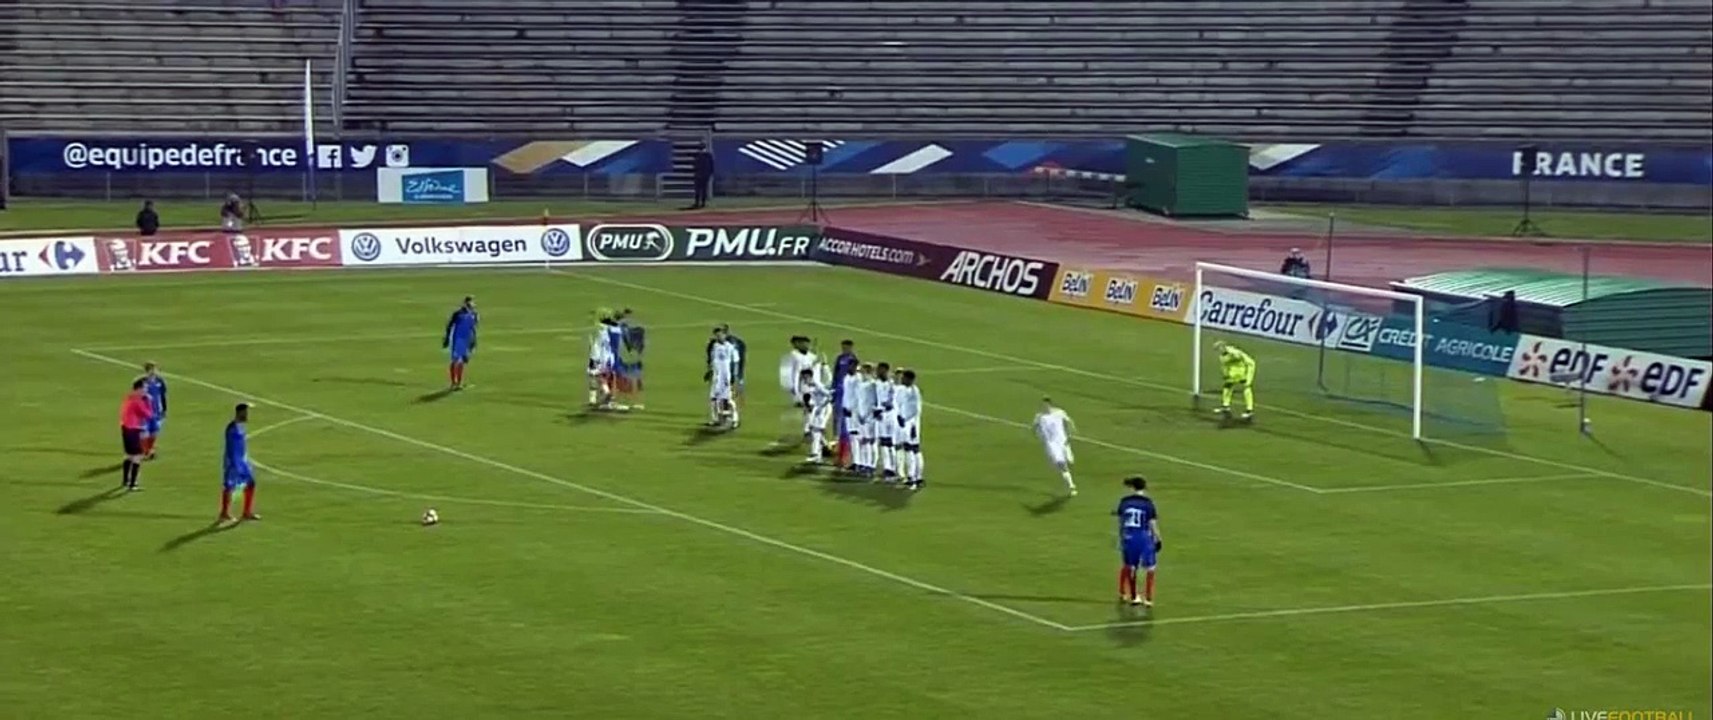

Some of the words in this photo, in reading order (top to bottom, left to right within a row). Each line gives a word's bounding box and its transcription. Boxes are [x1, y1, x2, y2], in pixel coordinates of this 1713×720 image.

[138, 241, 213, 265] KFC
[261, 237, 333, 260] KFC
[396, 237, 528, 257] Volkswagen
[599, 233, 643, 250] PMU
[685, 228, 810, 257] PMU.FR
[940, 251, 1044, 296] ARCHOS
[1198, 290, 1303, 337] Carrefour
[1434, 338, 1513, 362] AGRICOLE
